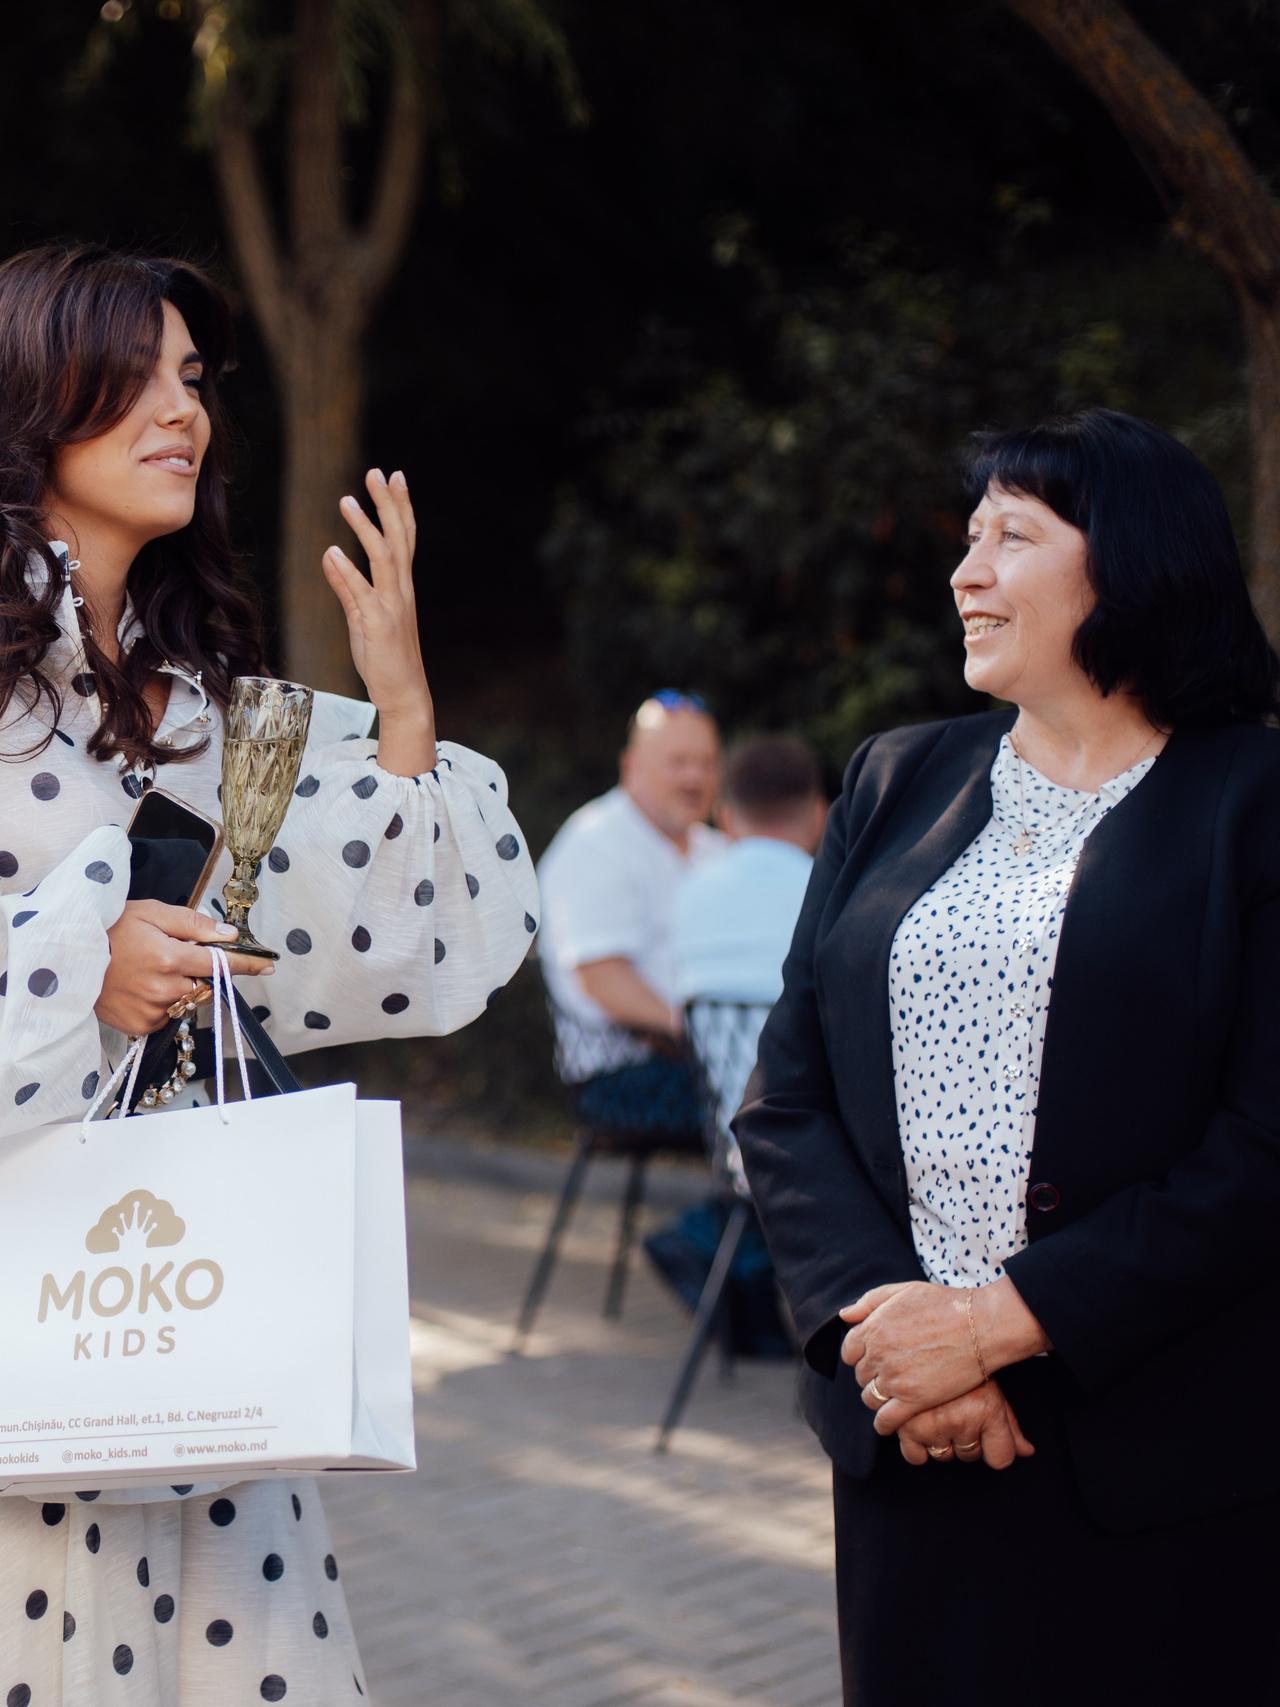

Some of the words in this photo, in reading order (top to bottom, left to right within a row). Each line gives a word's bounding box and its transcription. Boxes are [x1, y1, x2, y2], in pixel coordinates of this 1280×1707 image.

[37, 1257, 225, 1324] MOKO
[73, 1325, 177, 1361] KIDS
[68, 1417, 82, 1429] CC
[83, 1415, 114, 1428] Grand
[116, 1413, 139, 1427] Hall,
[141, 1412, 165, 1425] et.1,
[167, 1411, 184, 1423] Bd.
[187, 1407, 242, 1422] C.Negruzzi
[244, 1405, 263, 1420] 2/4
[74, 1446, 148, 1461] moko_kids.md
[187, 1440, 267, 1454] www.moko.md
